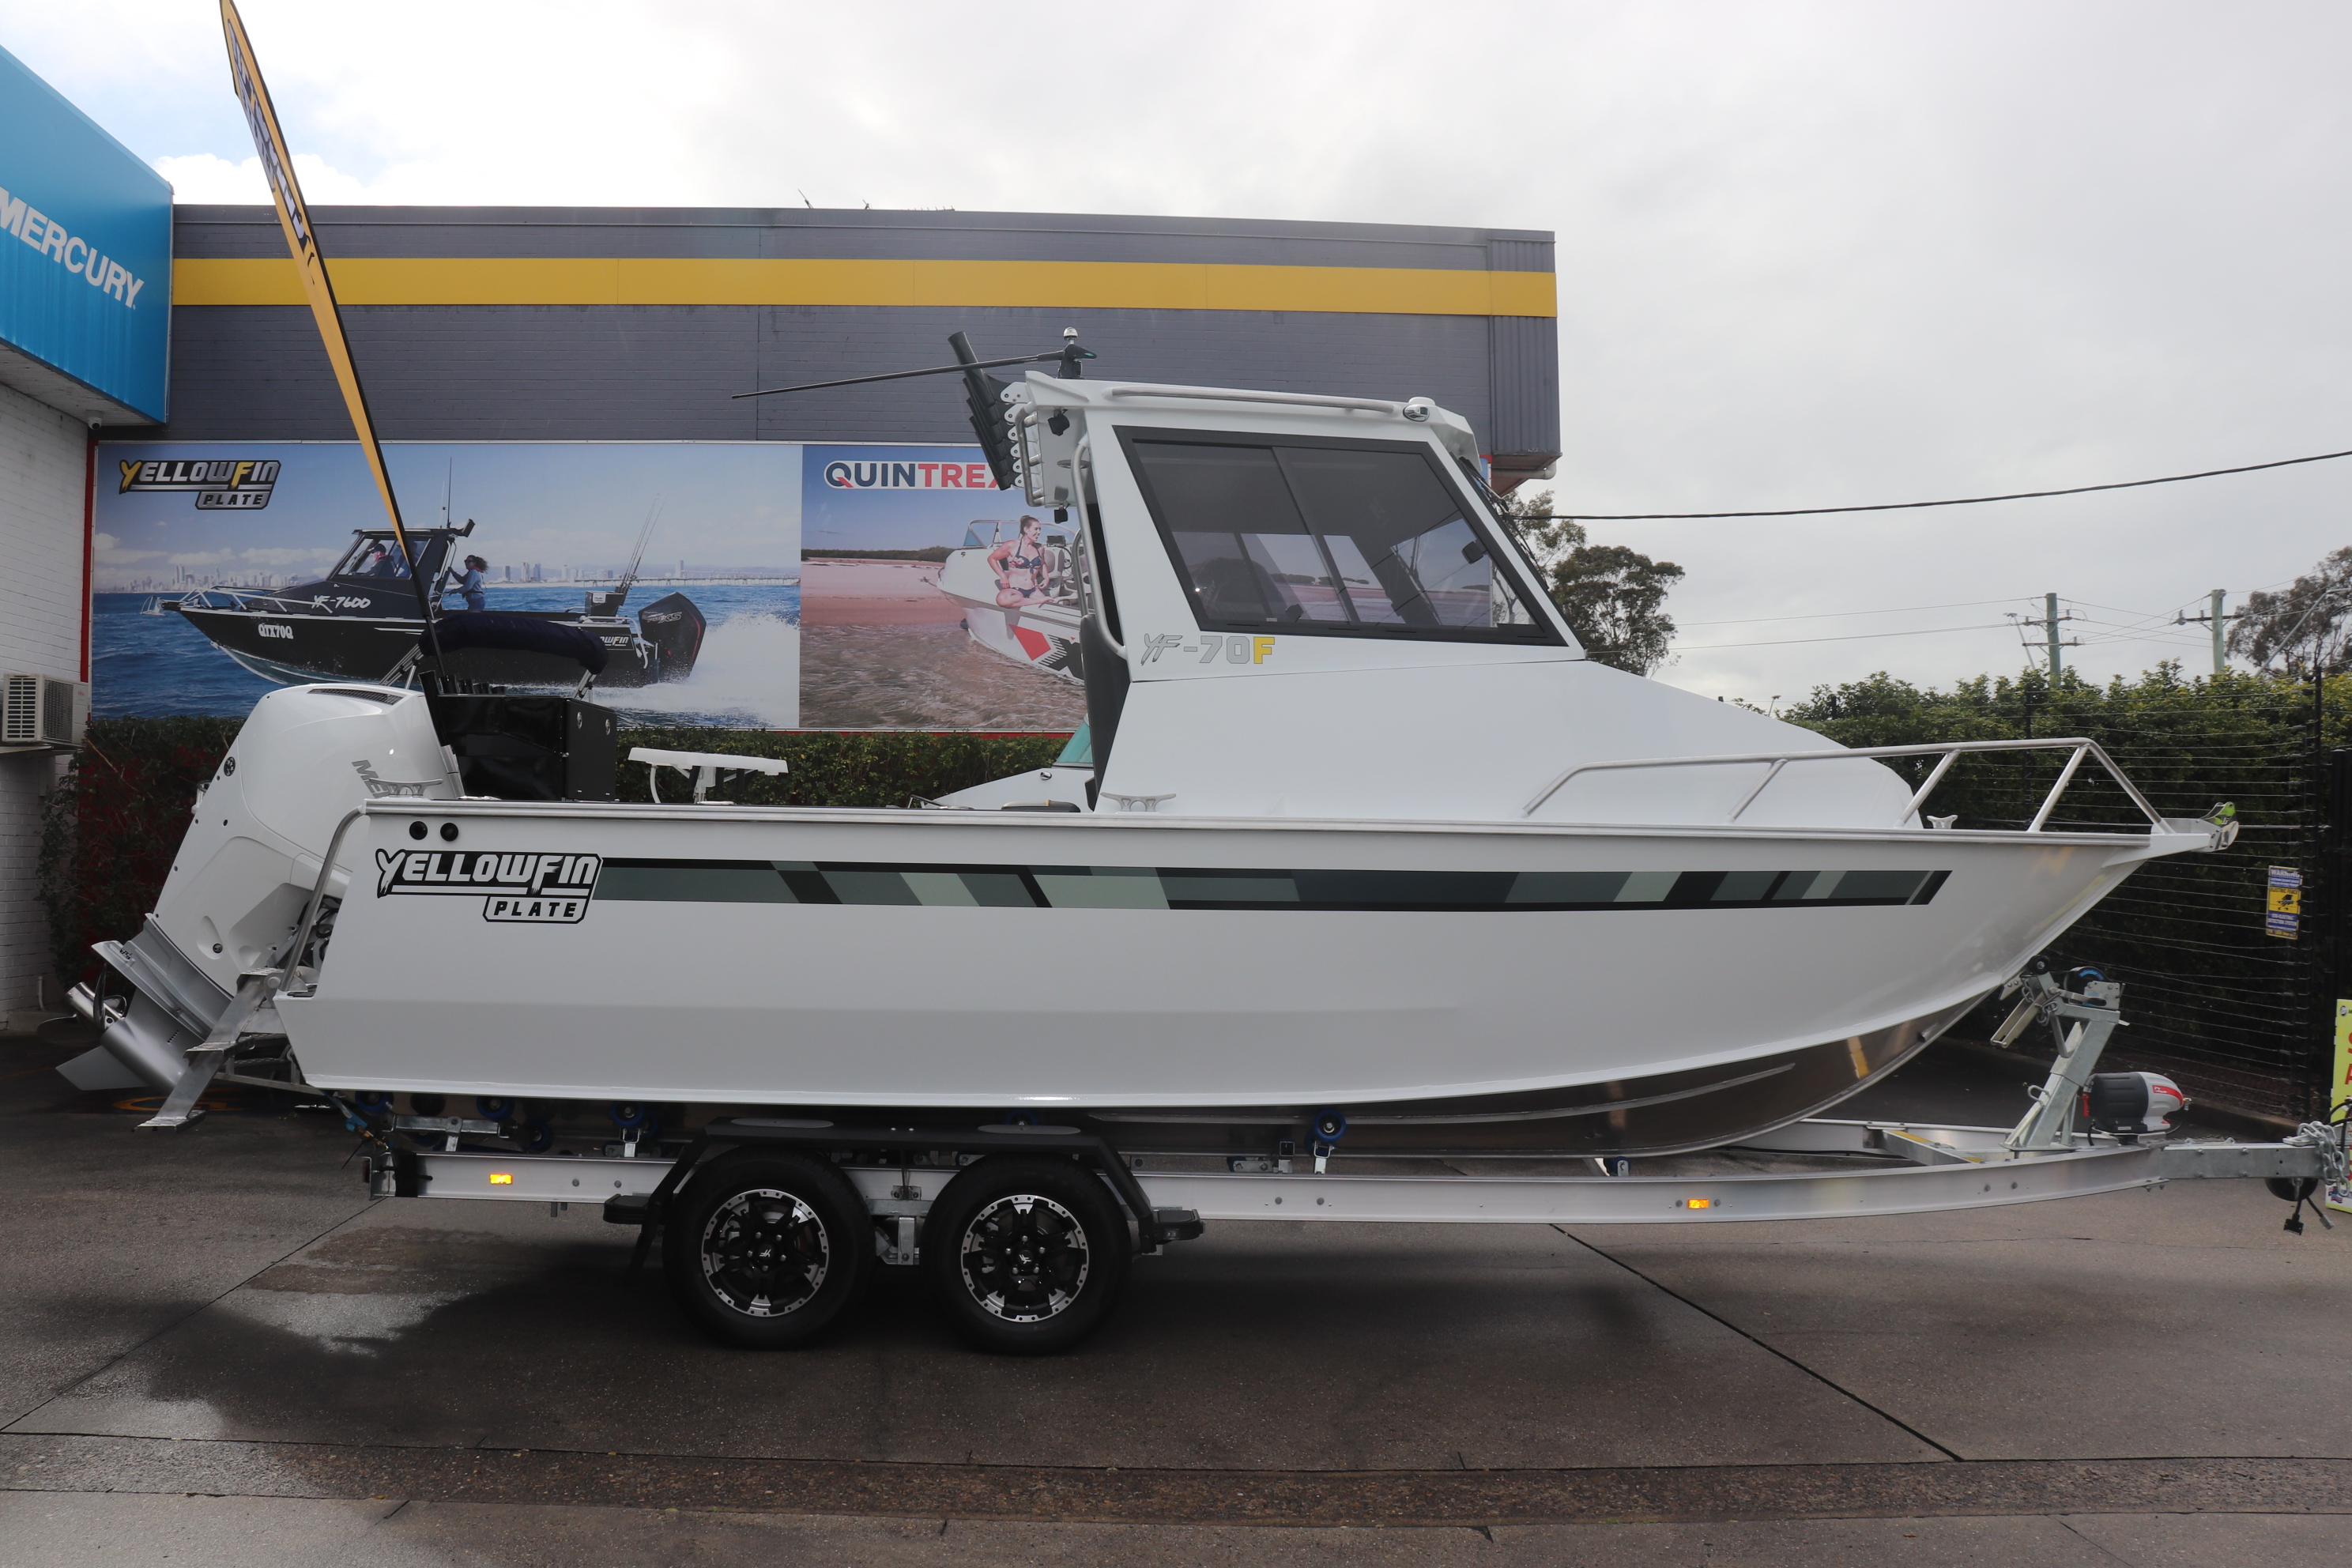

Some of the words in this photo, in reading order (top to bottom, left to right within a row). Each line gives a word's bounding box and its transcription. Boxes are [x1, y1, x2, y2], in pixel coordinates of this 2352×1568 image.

[0, 186, 145, 310] MERCURY
[119, 460, 281, 493] YELLOWFIN
[202, 494, 263, 506] PLATE
[1140, 633, 1276, 666] YF-70F
[375, 848, 603, 899] YELLOWFIN
[493, 901, 577, 918] PLATE
